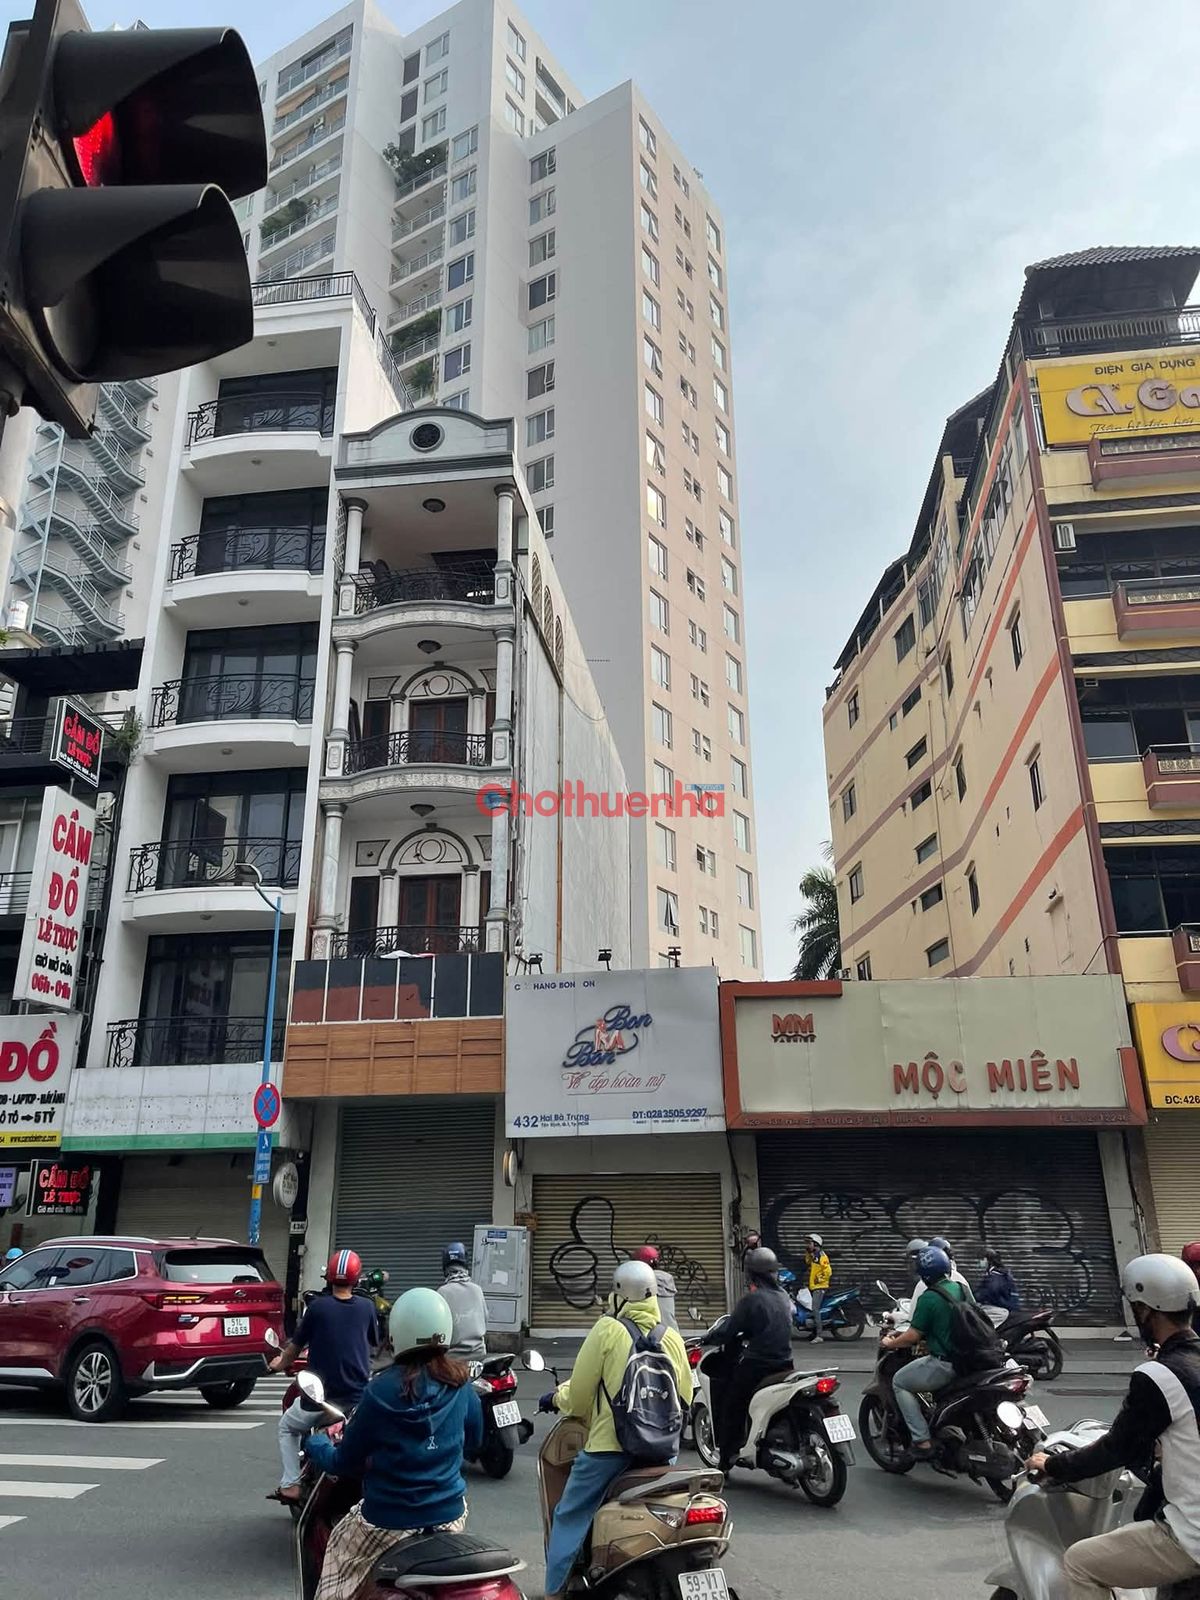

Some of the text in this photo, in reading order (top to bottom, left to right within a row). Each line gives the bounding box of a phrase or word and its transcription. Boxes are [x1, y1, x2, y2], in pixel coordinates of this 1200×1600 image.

[1095, 358, 1196, 376] ĐIỆN GIA DỤNG
[52, 809, 94, 866] CẦM
[48, 866, 80, 918] ĐỒ
[558, 981, 576, 990] BON
[603, 1005, 653, 1032] Bon
[893, 1049, 1080, 1101] MỘC MIÊN
[513, 1115, 539, 1128] 432
